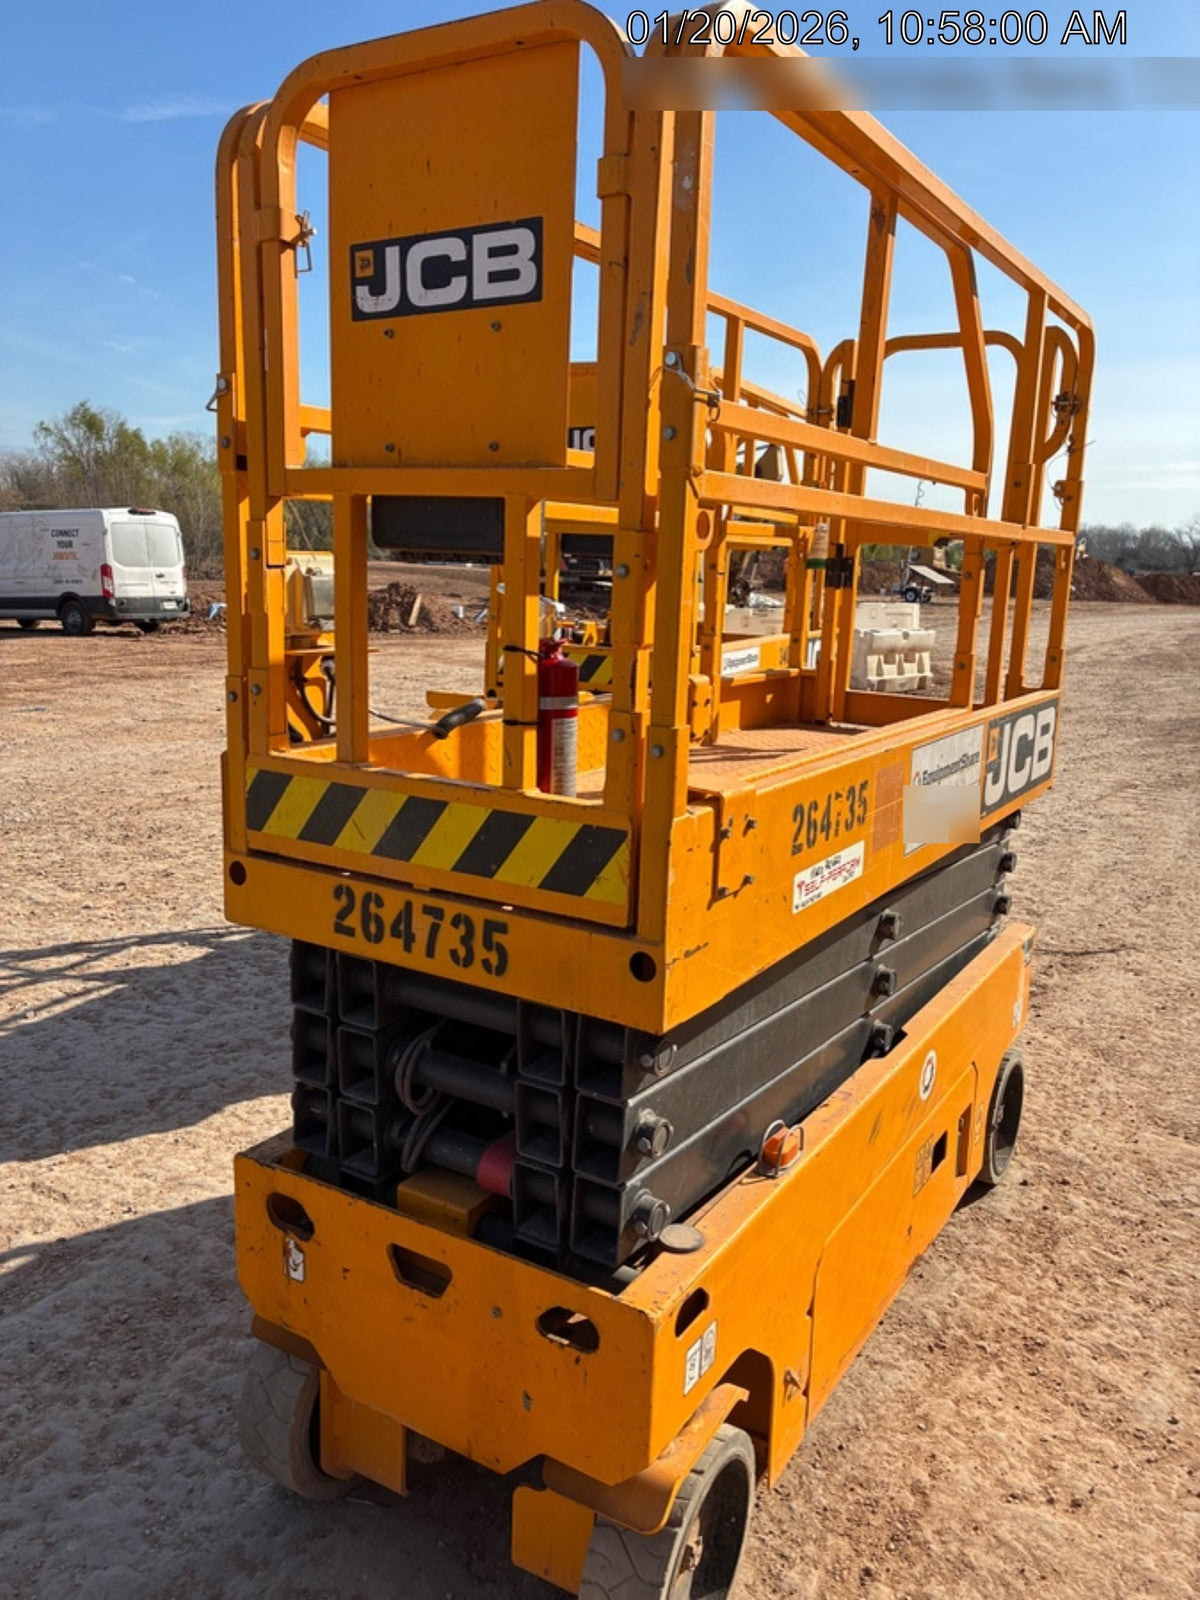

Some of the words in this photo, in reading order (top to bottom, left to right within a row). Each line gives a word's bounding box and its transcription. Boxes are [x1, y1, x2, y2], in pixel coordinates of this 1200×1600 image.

[355, 227, 537, 313] JCB
[984, 706, 1056, 806] JCB
[791, 779, 869, 857] 264735
[333, 883, 509, 977] 264735
